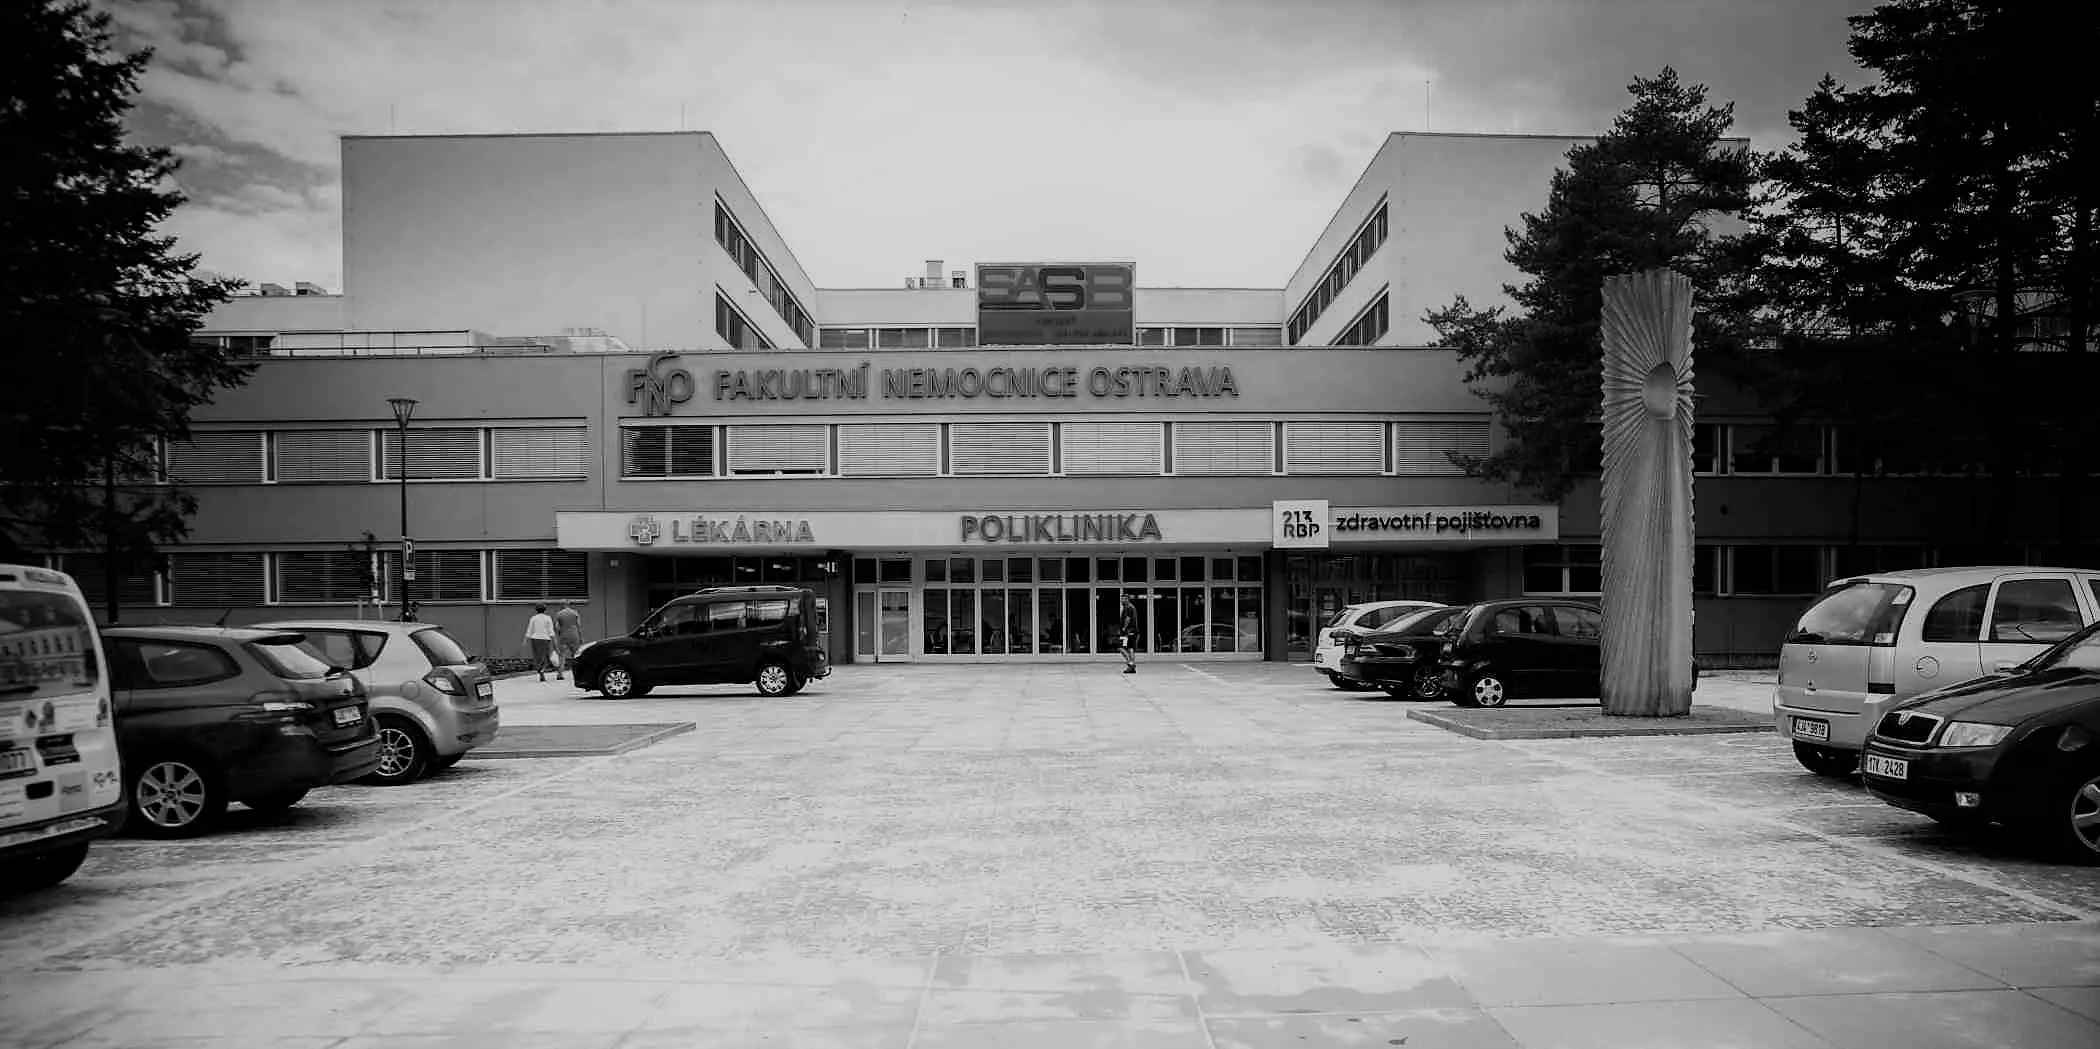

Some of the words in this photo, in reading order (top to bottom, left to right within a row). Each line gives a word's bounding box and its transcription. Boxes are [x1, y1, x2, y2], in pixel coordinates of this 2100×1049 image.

[714, 360, 870, 401] FAKULTNÍ
[881, 366, 1079, 400] NEMOCNICE
[1087, 365, 1240, 400] OSTRAVA
[1282, 510, 1312, 523] 213
[1335, 511, 1431, 531] zdravotní
[1436, 510, 1540, 533] pojišťovna
[671, 513, 815, 543] LÉKÁRNA
[960, 513, 1162, 542] POLIKLINIKA
[1283, 523, 1320, 537] RBP
[405, 541, 413, 561] P
[1884, 760, 1904, 777] 2428
